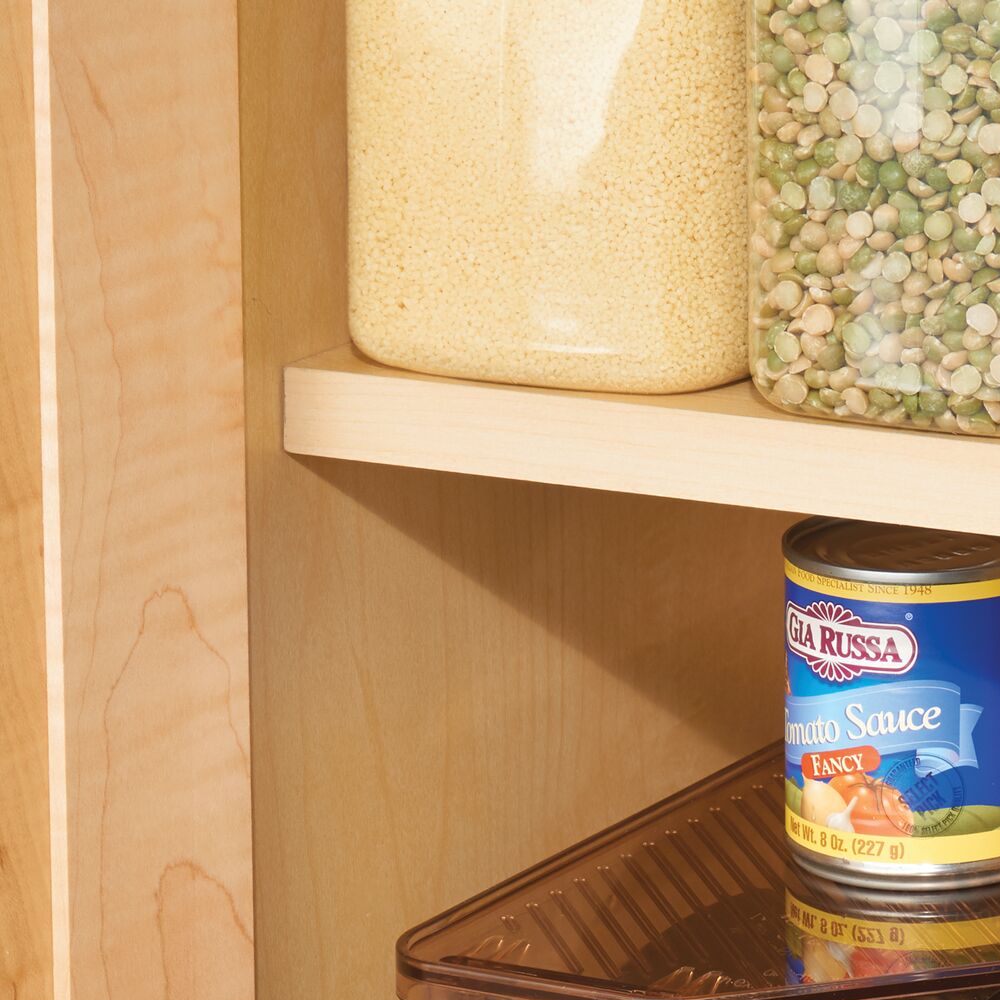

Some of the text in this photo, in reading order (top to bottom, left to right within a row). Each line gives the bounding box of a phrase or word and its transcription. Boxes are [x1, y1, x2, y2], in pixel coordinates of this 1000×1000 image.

[867, 584, 898, 595] SINCE
[903, 585, 932, 596] 1948
[789, 611, 903, 664] GIA RUSSA
[844, 703, 942, 741] Sauce
[810, 752, 863, 777] FANCY
[898, 771, 939, 807] SELECT
[914, 789, 947, 819] PICK
[790, 815, 905, 860] Net Wt. 8 Oz. (227 g)
